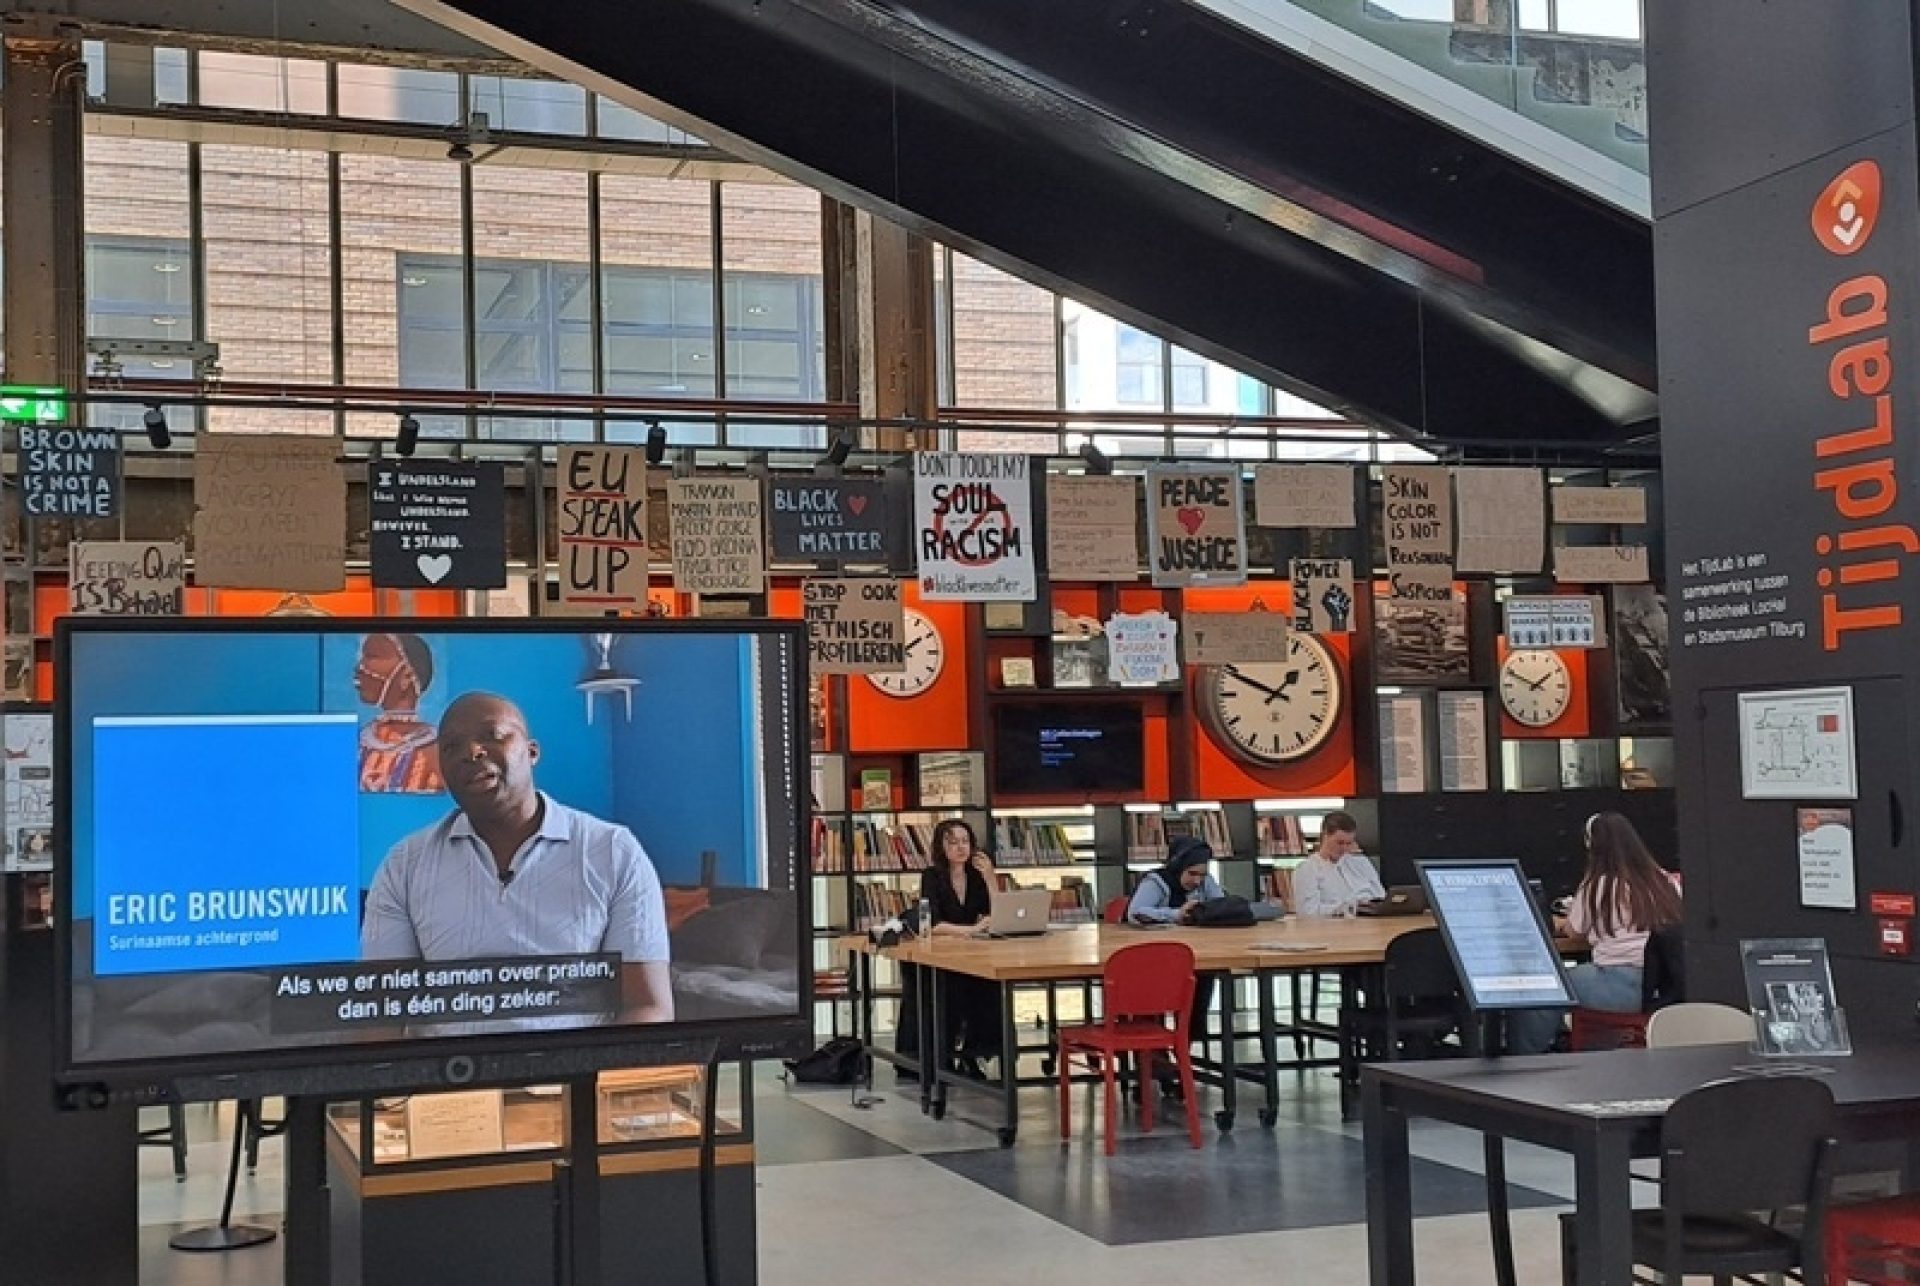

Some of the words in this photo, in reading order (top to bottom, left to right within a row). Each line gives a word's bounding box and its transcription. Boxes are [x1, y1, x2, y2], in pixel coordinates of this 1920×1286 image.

[20, 426, 117, 450] BROWN
[28, 450, 93, 473] SKIN
[568, 450, 629, 492] EU
[961, 455, 999, 478] TOUCH
[1003, 455, 1026, 480] MY
[1809, 274, 1920, 650] TijdLab
[23, 474, 44, 491] IS
[50, 475, 92, 492] NOT
[96, 477, 110, 493] A
[1160, 476, 1231, 509] PEACE
[25, 493, 112, 517] CRIME
[774, 488, 840, 512] BLACK
[931, 482, 1007, 515] SOUL
[561, 499, 645, 541] SPEAK
[801, 512, 845, 526] LIVES
[1409, 522, 1441, 540] NOT
[798, 532, 882, 554] MATTER
[921, 527, 1022, 561] RACISM
[570, 544, 630, 594] UP
[803, 582, 848, 601] STOP
[861, 584, 899, 601] OOK
[809, 619, 895, 640] ETNISCH
[108, 892, 177, 926] ERIC
[187, 885, 349, 923] BRUNSWIJK
[109, 932, 191, 951] Surinaamse
[195, 927, 280, 947] achtergrond
[276, 975, 311, 997] Als
[316, 977, 349, 995] we
[354, 974, 376, 992] er
[381, 968, 420, 990] niet
[424, 967, 493, 987] samen
[498, 964, 542, 983] over
[548, 959, 616, 984] praten,
[337, 999, 378, 1020] dan
[382, 997, 402, 1017] is
[407, 992, 446, 1015] één
[450, 990, 494, 1015] ding
